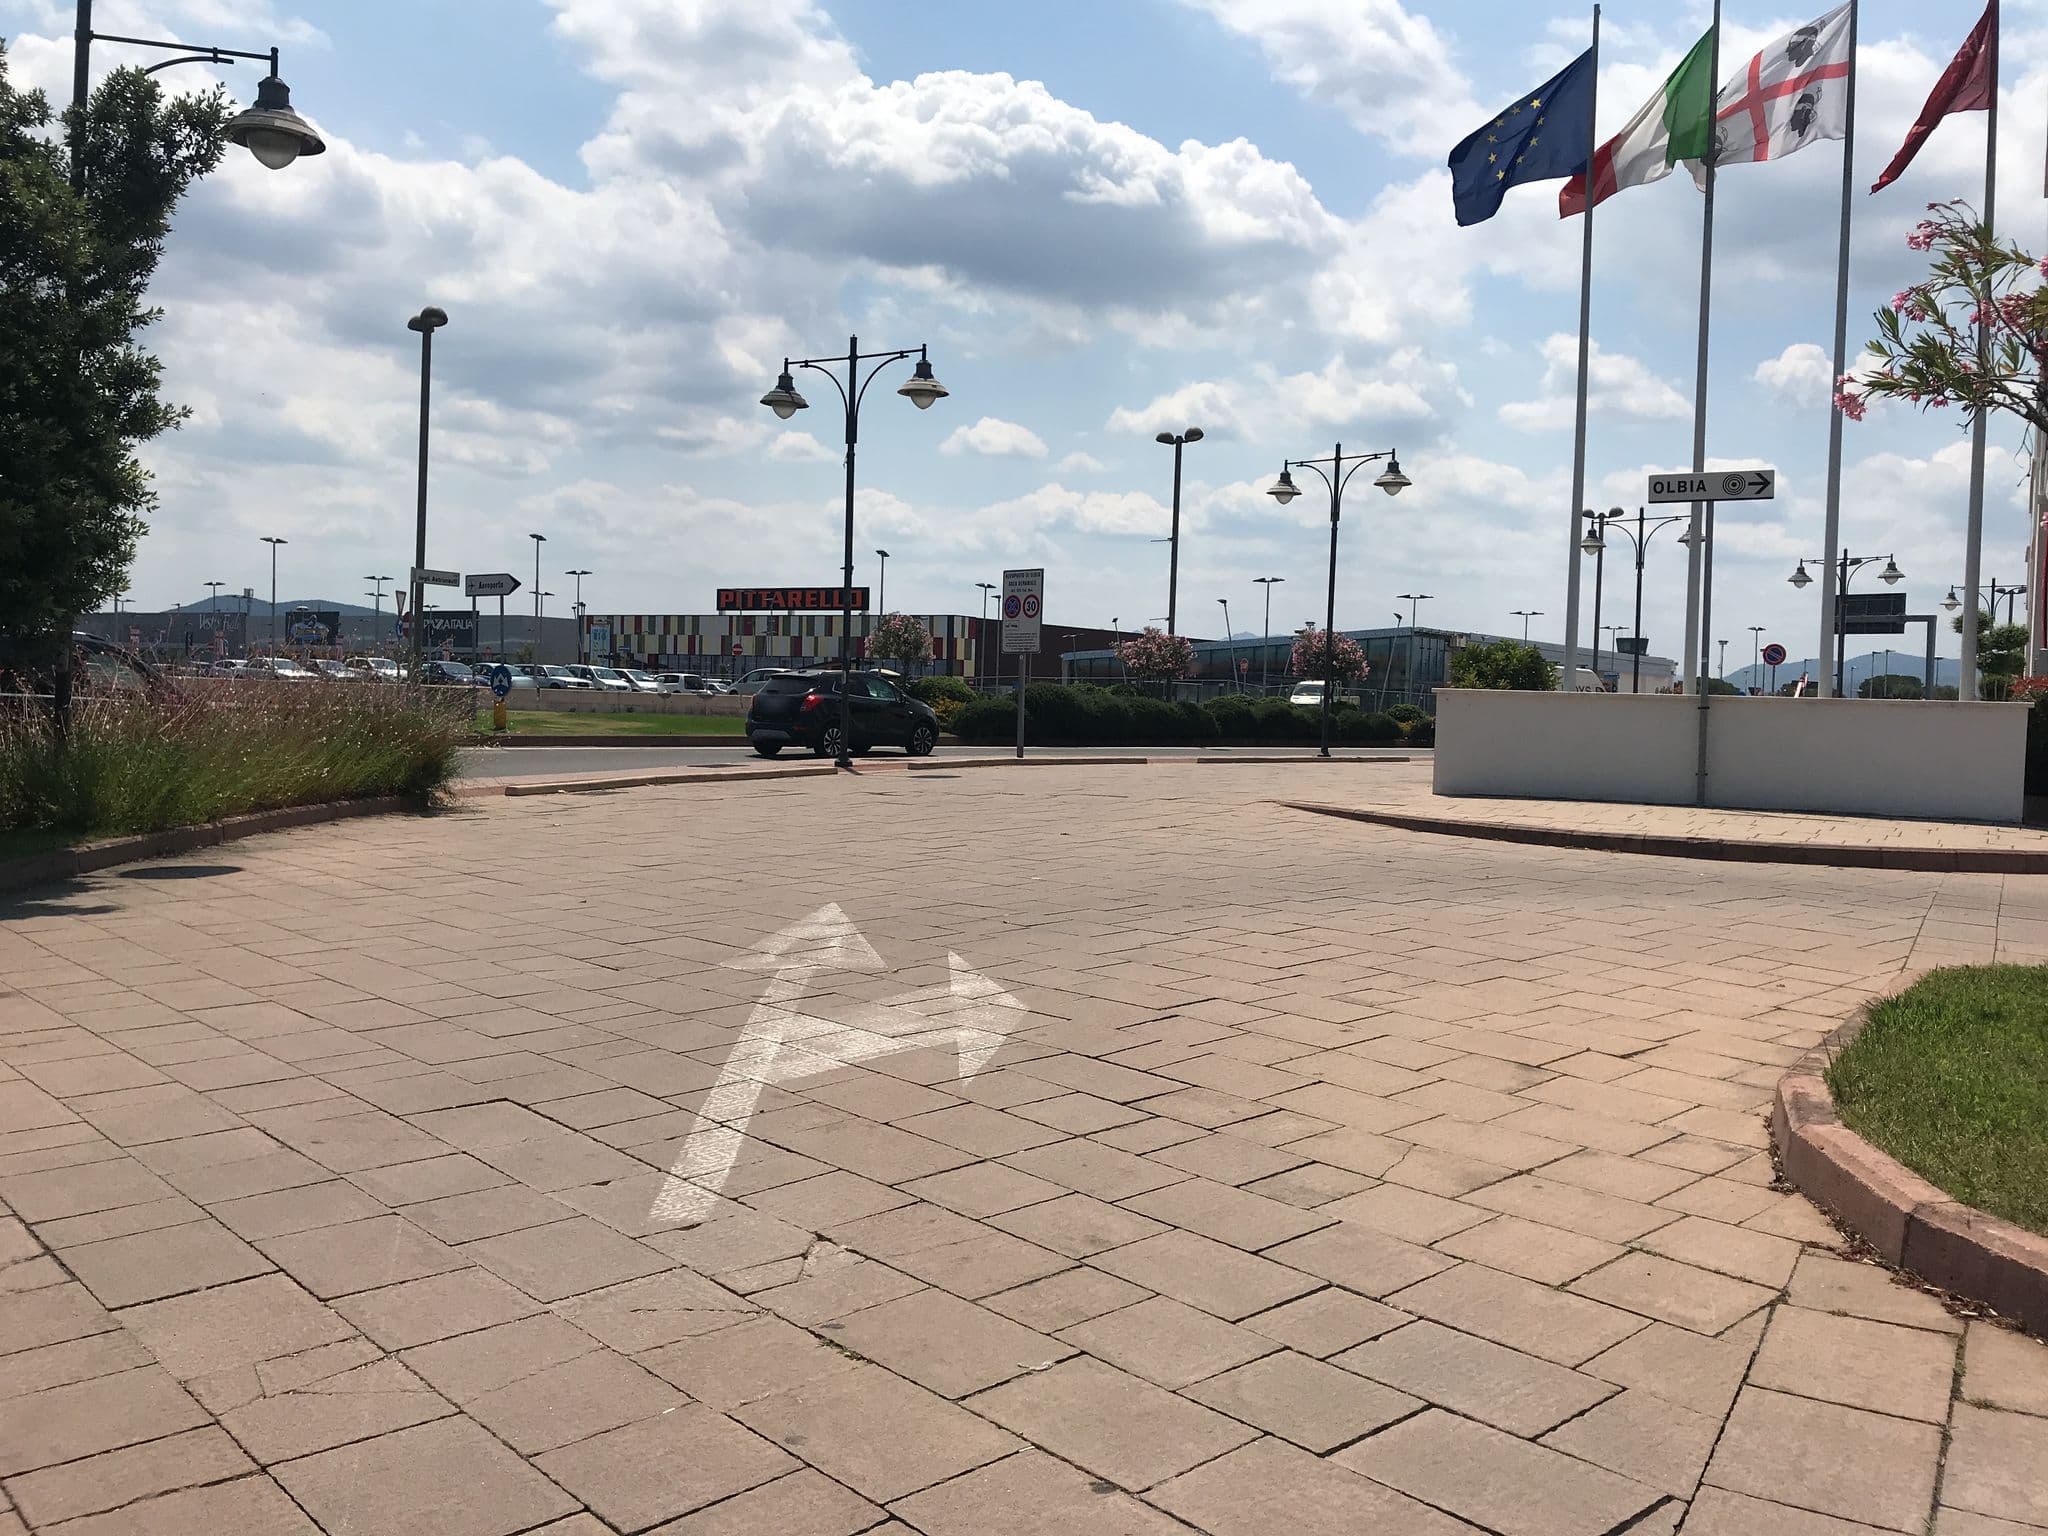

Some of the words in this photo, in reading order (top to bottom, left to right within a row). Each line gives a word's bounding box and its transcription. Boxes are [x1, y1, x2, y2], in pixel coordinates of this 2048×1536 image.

[1653, 480, 1706, 494] OLBIA
[478, 581, 504, 590] Aeroporto
[719, 590, 863, 608] PITTARELLO
[1026, 600, 1036, 612] 30
